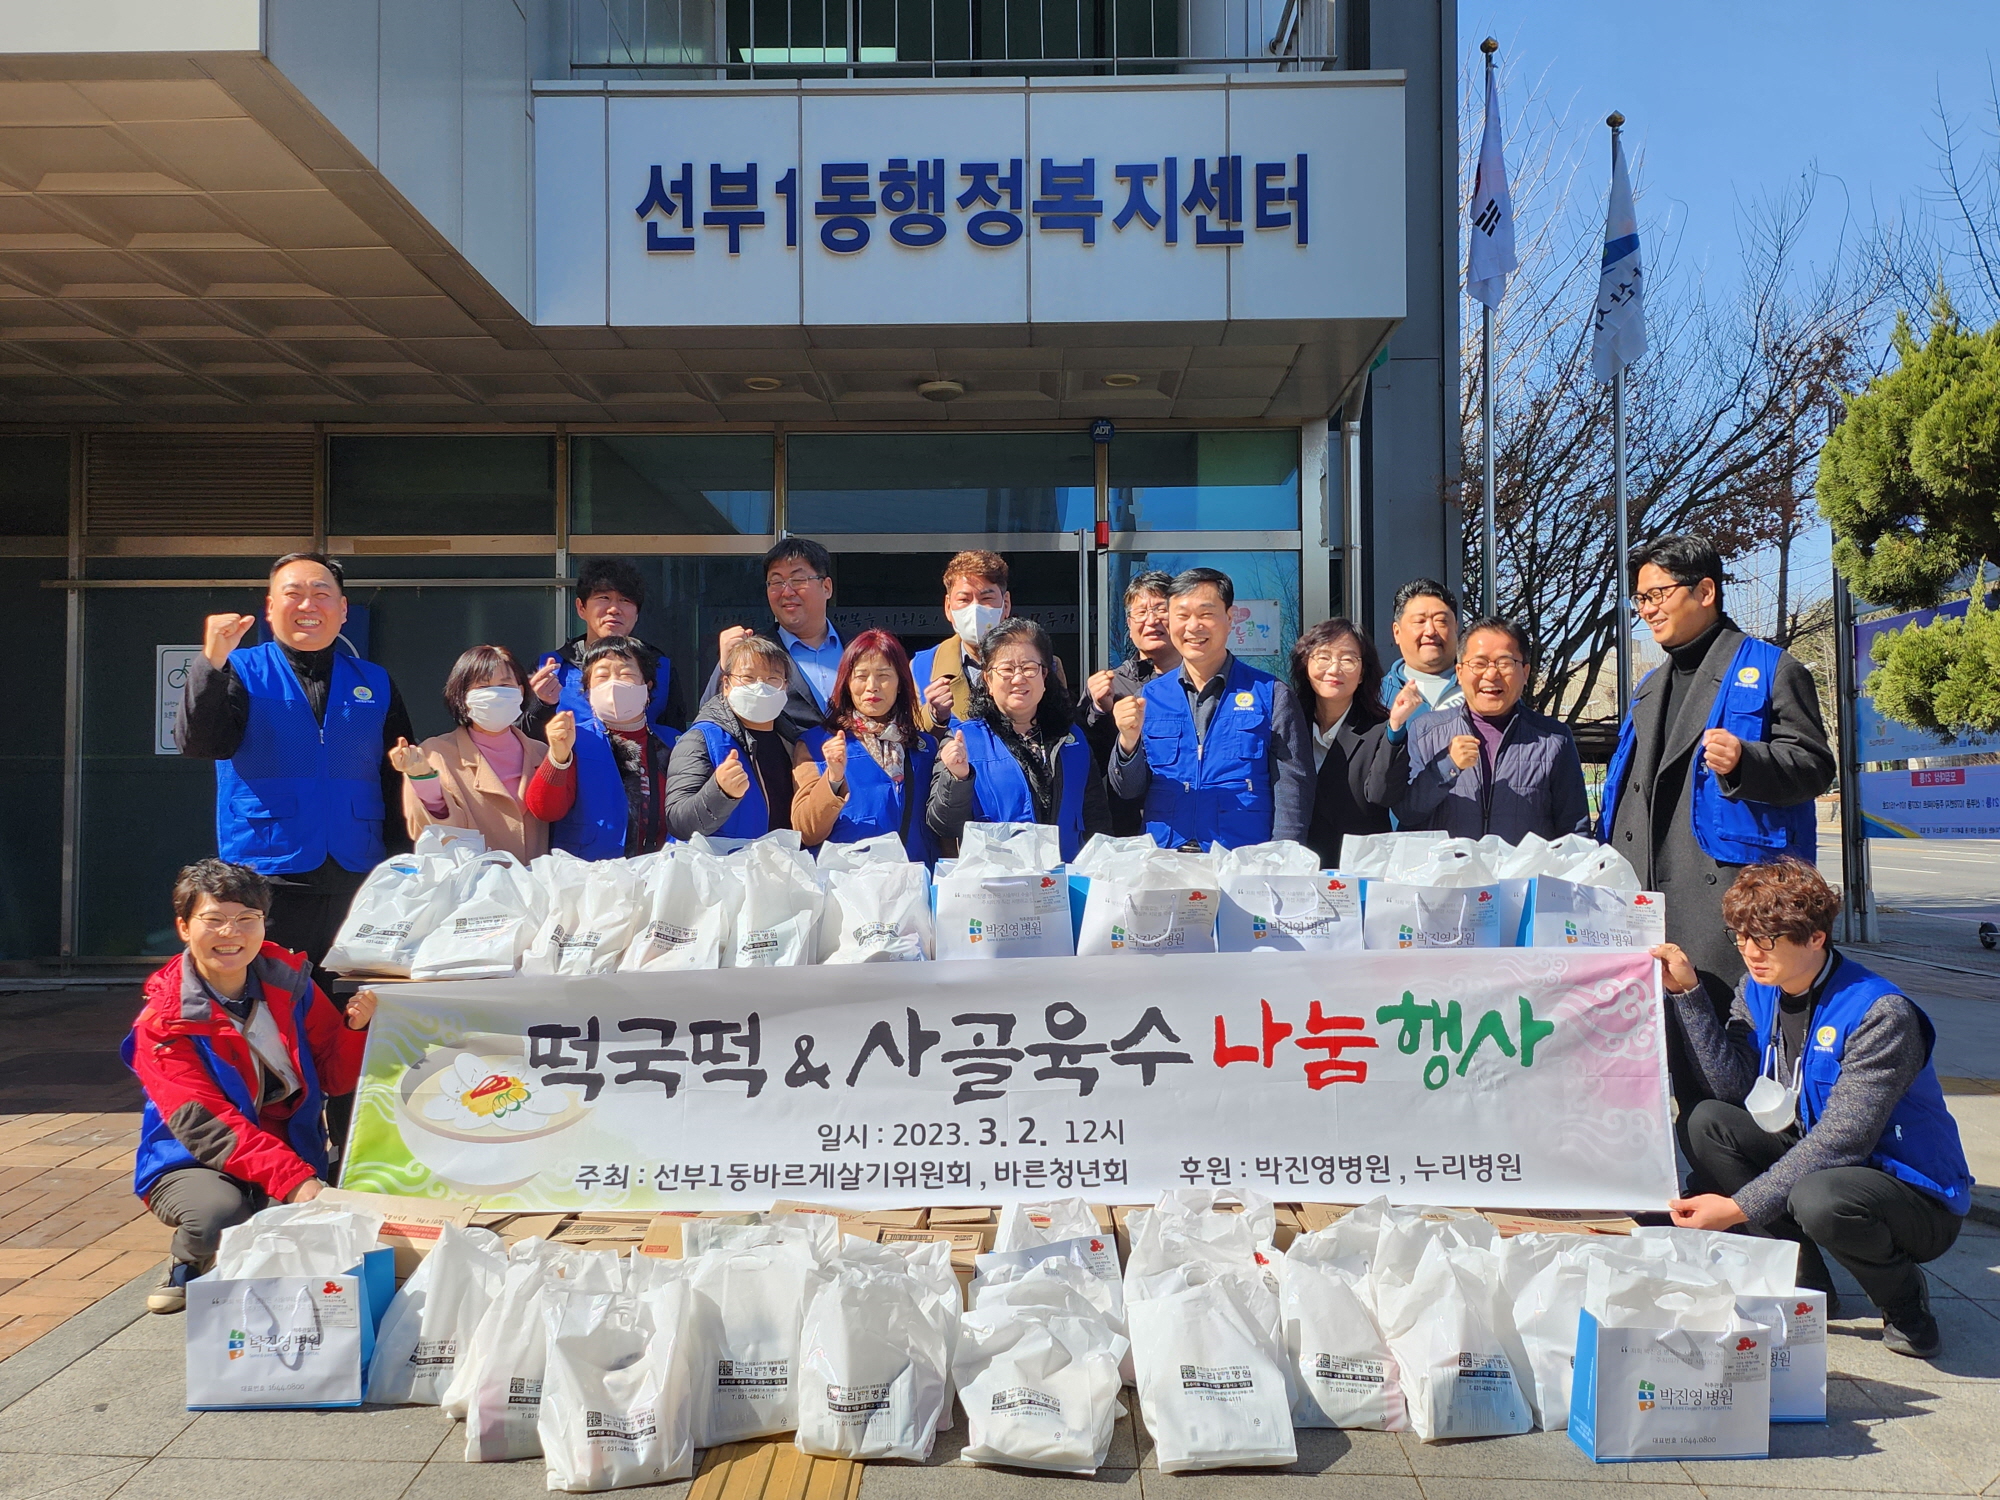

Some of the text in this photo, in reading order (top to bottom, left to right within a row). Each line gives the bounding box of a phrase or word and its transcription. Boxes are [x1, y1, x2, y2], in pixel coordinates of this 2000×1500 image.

[635, 153, 1308, 254] 선부1동행정복지센터
[1094, 426, 1110, 434] ADT
[986, 921, 1042, 938] 박진영 병원
[1270, 921, 1330, 935] 박진영 병원
[1128, 932, 1184, 948] 박진영 병원
[1416, 932, 1450, 945] 박진영
[1580, 929, 1609, 945] 박진영
[528, 1011, 768, 1102] 떡국떡
[784, 1033, 831, 1090] &
[846, 1001, 1194, 1106] 사골육수
[1065, 1118, 1125, 1146] 12시
[994, 1157, 1128, 1189] 바른청년회
[1413, 1153, 1522, 1184] 누리병원
[250, 1333, 321, 1352] 박진영 병원
[735, 1365, 788, 1376] 누리 병원
[1332, 1360, 1349, 1371] 누리
[1198, 1370, 1251, 1380] 누리 병원
[840, 1388, 890, 1402] 누리 병원
[1660, 1388, 1733, 1406] 박진영 병원
[604, 1418, 621, 1430] 누리
